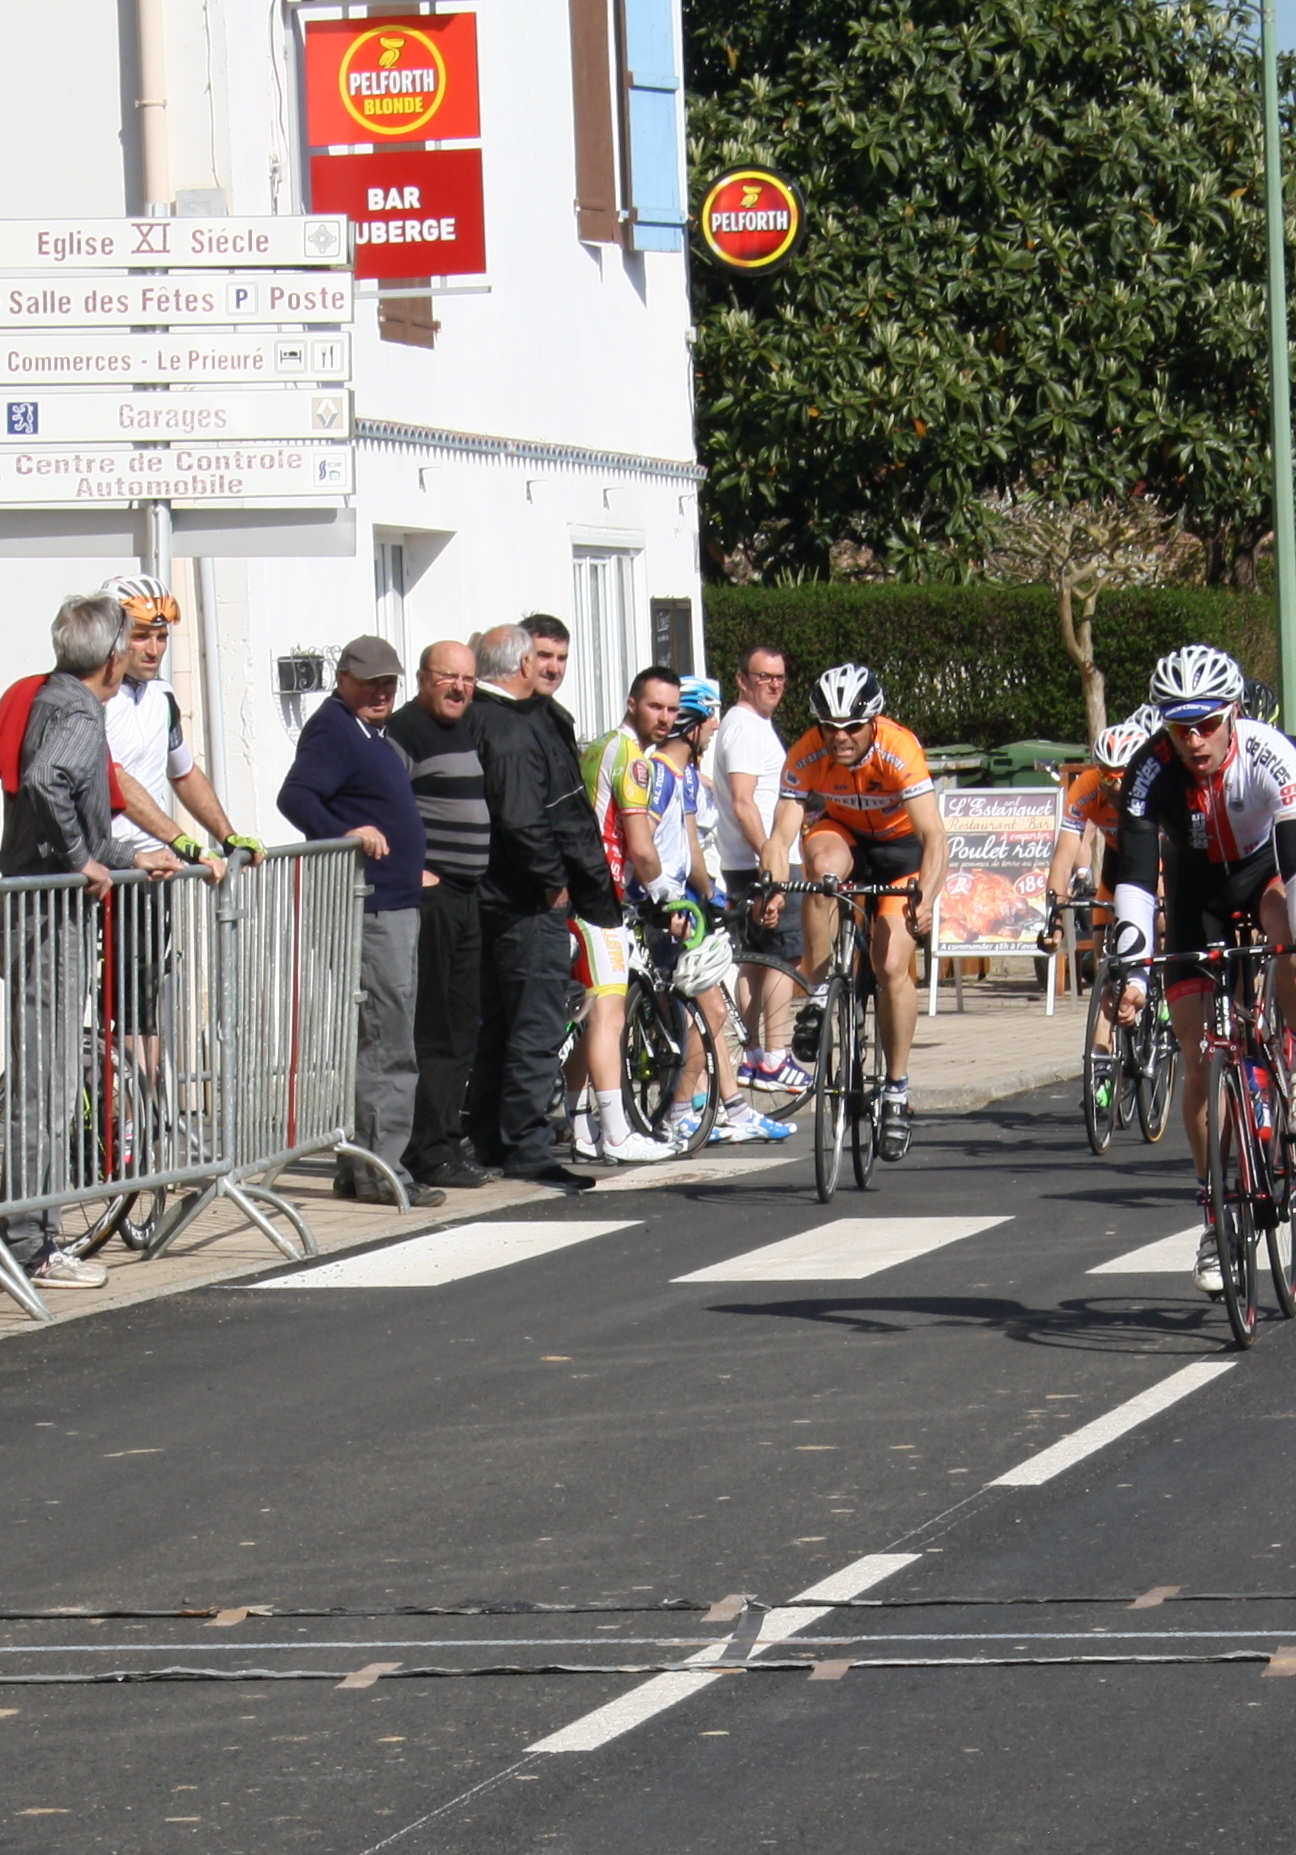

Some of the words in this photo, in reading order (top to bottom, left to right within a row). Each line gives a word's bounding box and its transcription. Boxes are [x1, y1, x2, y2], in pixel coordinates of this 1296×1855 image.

[349, 69, 435, 96] PELFORTH
[364, 97, 424, 115] BLONDE
[368, 186, 421, 211] BAR
[355, 218, 457, 245] UBERGE
[711, 210, 788, 232] PELFORTH
[37, 231, 114, 261] Eglise
[131, 223, 171, 254] XI
[8, 290, 72, 315] Salle
[84, 289, 129, 313] des
[141, 287, 214, 312] Fêtes
[235, 288, 248, 309] P
[269, 286, 345, 311] Poste
[7, 351, 131, 372] Commerces
[157, 350, 181, 371] Le
[189, 347, 264, 370] Prieuré
[119, 404, 227, 434] Garages
[15, 453, 115, 475] Centre
[129, 453, 162, 473] de
[176, 449, 303, 472] Controle
[76, 475, 243, 498] Automobile
[948, 797, 1052, 818] L'Estanquet
[947, 817, 1017, 830] Restaurant
[1025, 817, 1051, 830] Bar
[947, 834, 1009, 858] Poulet
[1012, 842, 1051, 858] rôti
[1017, 875, 1045, 894] 18€
